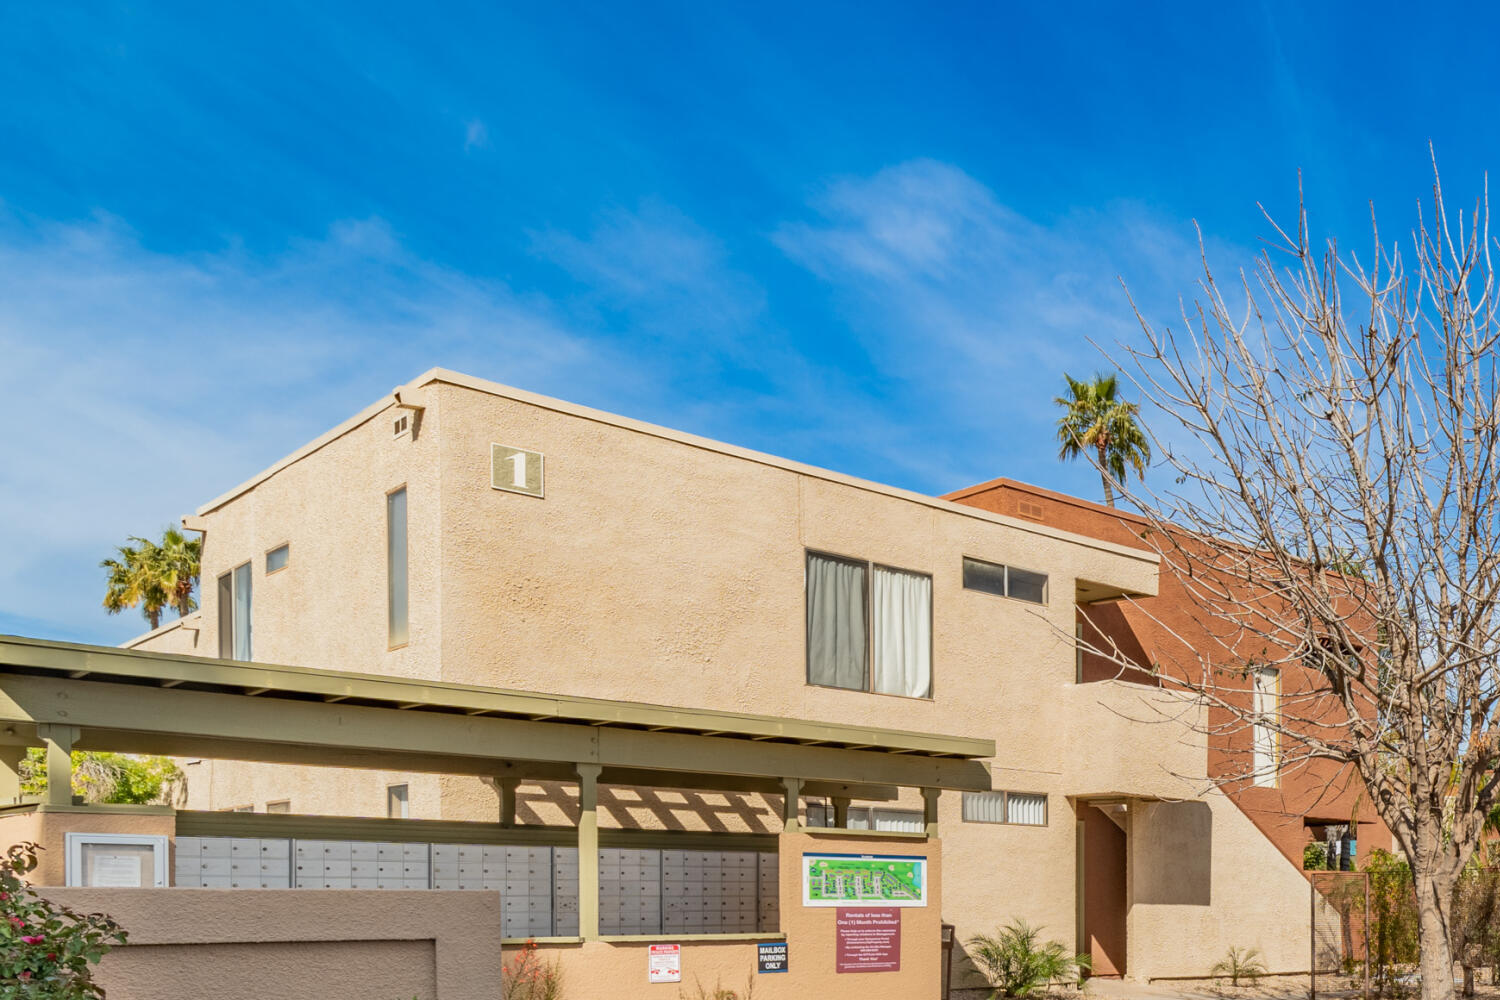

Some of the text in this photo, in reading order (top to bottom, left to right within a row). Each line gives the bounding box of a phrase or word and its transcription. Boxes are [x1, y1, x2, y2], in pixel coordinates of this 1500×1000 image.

[504, 452, 528, 489] 1
[760, 946, 786, 954] MAILBOX
[760, 954, 786, 962] PARKING
[765, 962, 781, 970] ONLY
